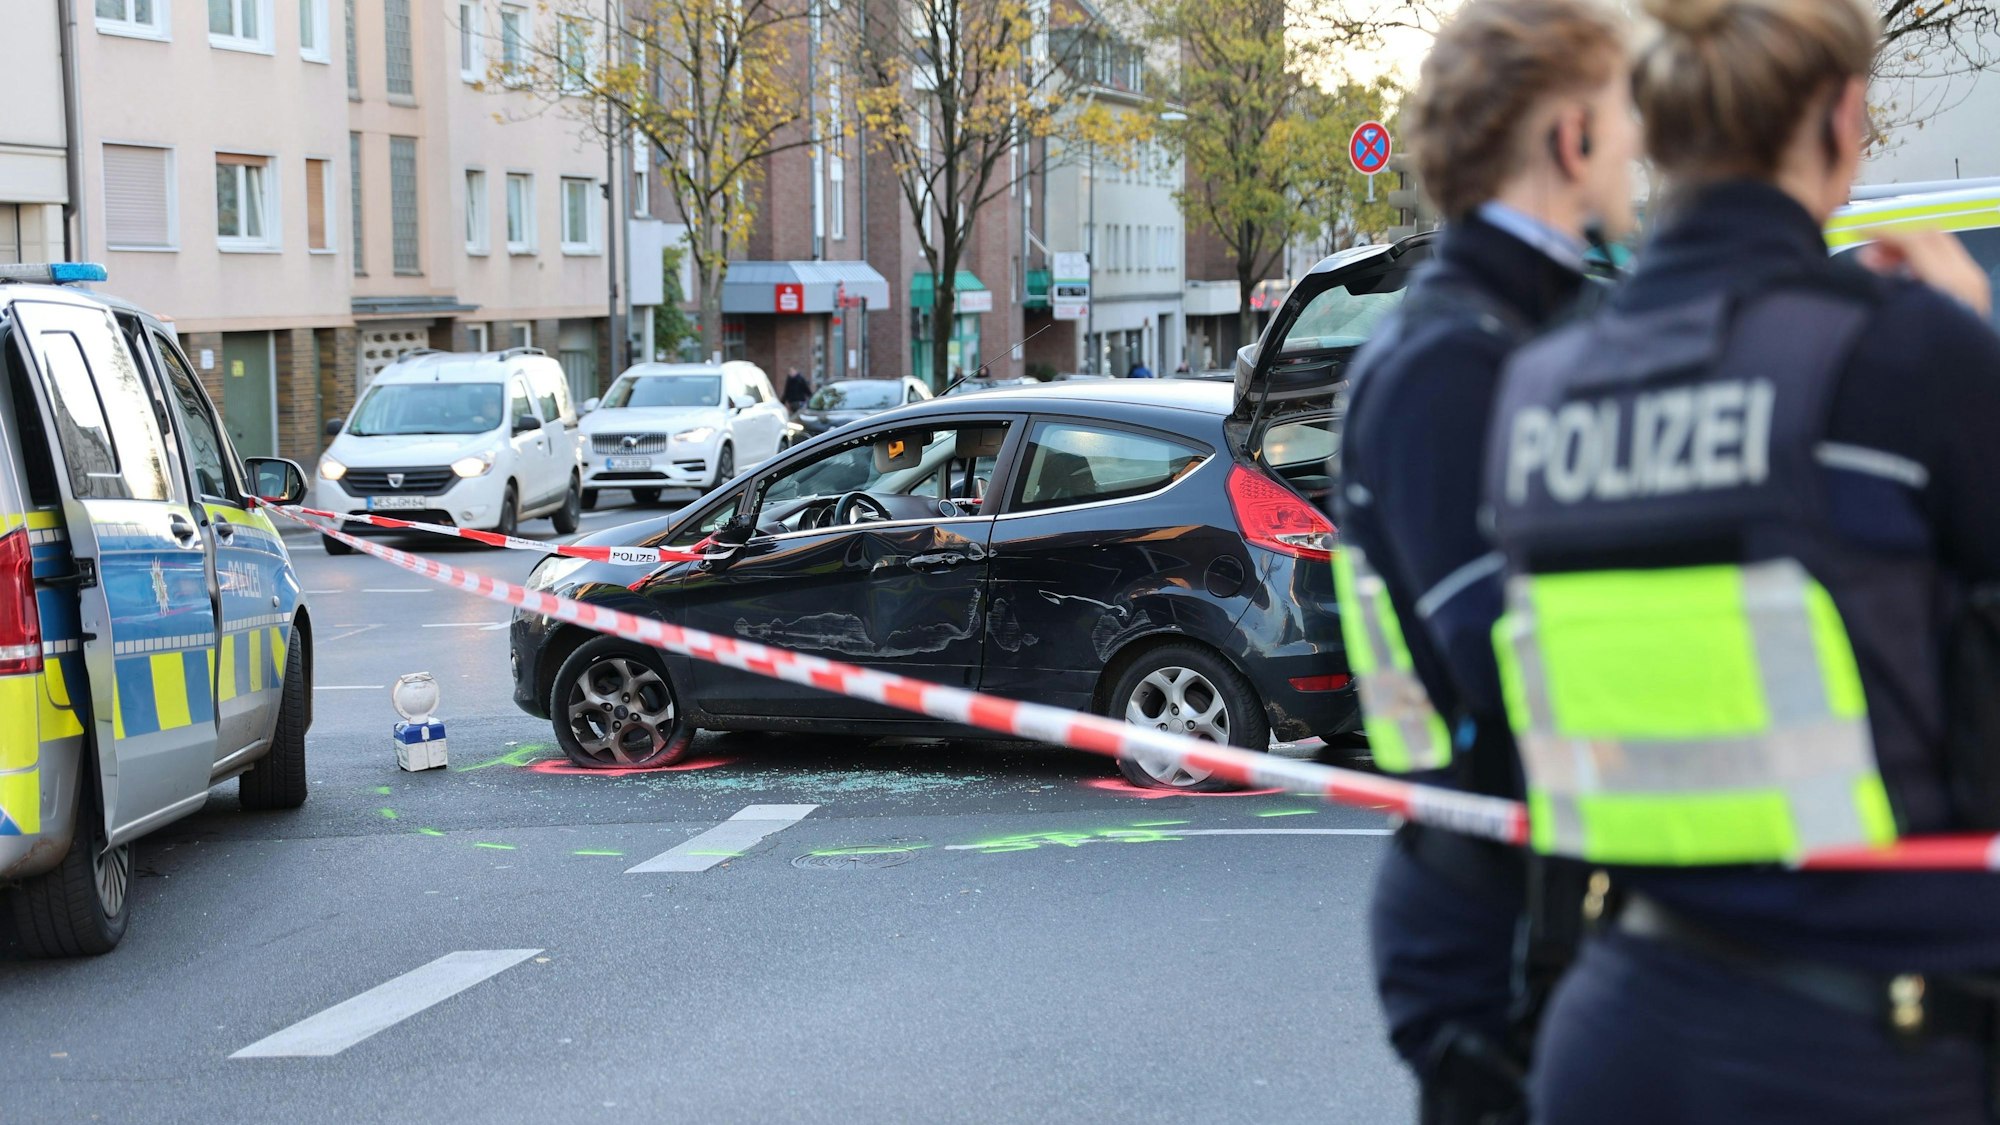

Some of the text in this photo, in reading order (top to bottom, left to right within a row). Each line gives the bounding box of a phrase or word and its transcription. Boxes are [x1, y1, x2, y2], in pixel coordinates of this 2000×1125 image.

[1506, 379, 1775, 505] POLIZEI
[613, 551, 656, 562] POLIZEI
[228, 560, 262, 598] POLIZEI
